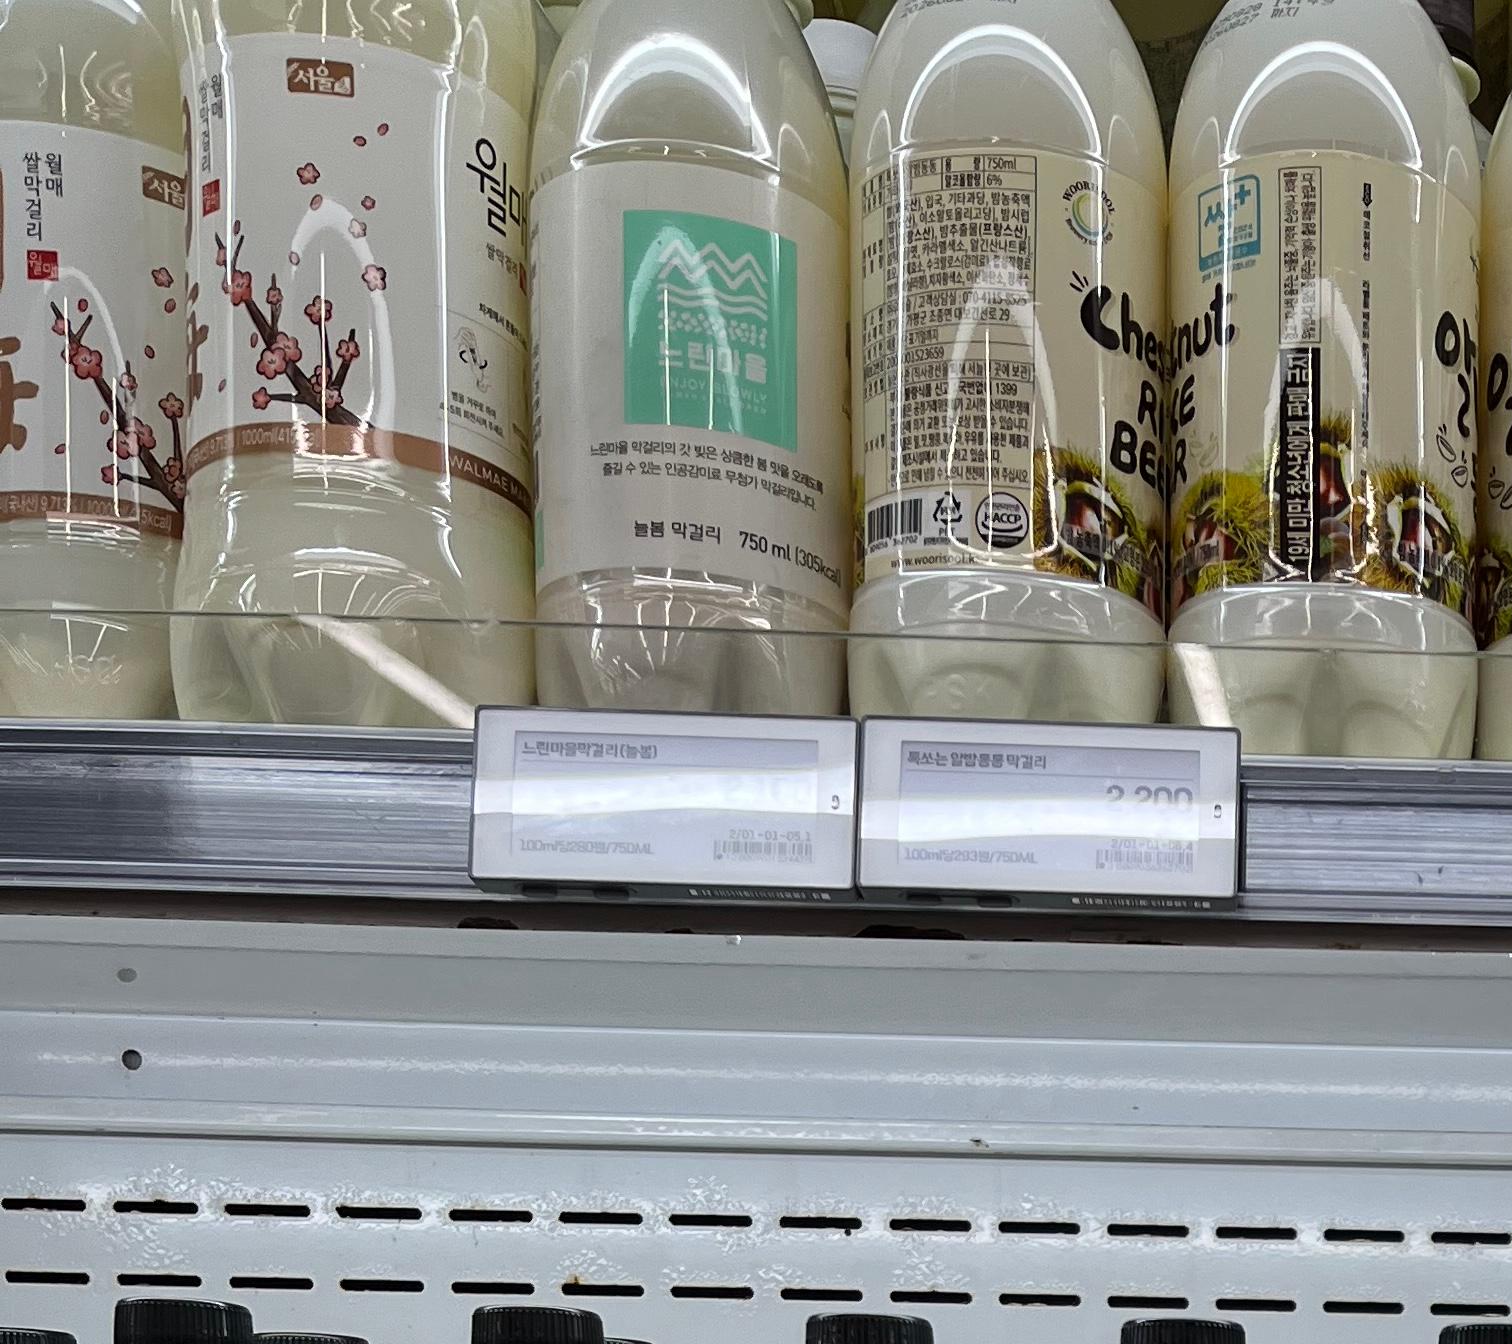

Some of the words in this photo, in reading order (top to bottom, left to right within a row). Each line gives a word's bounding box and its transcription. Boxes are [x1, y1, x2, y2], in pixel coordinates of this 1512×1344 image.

[45, 153, 63, 197] 월매
[672, 522, 720, 544] 막걸리
[739, 531, 767, 553] 750
[771, 543, 791, 562] ml
